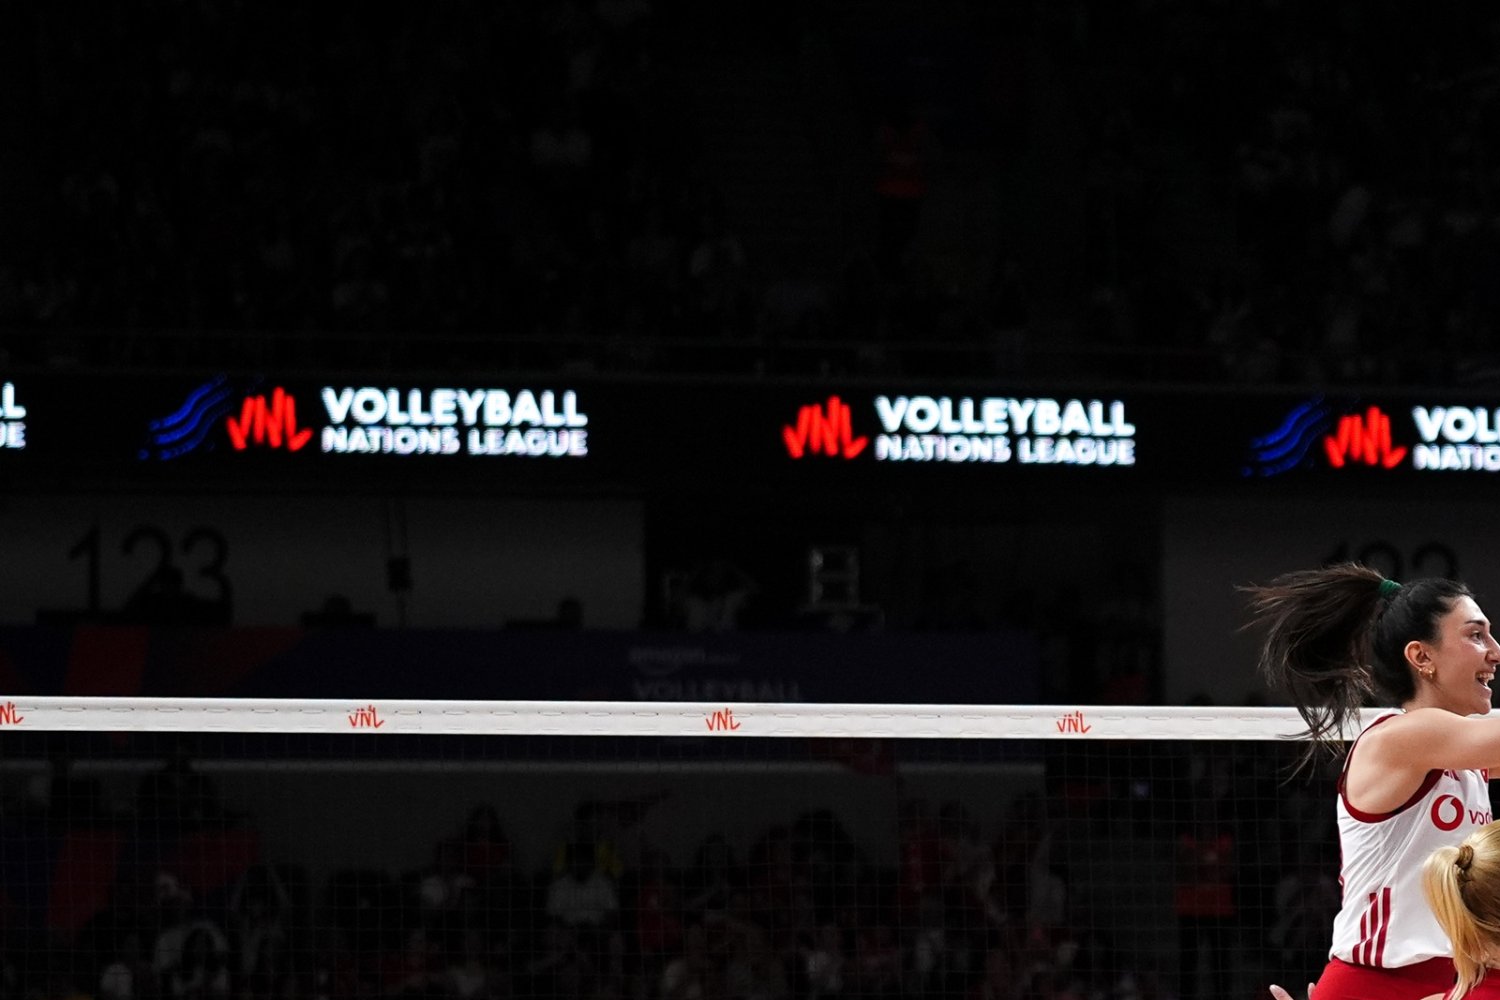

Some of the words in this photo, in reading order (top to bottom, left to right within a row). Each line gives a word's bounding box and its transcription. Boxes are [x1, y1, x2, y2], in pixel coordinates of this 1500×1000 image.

[321, 387, 588, 427] VOLLEYBALL
[876, 396, 1136, 437] VOLLEYBALL
[321, 427, 461, 454] NATIONS
[468, 429, 588, 456] LEAGUE
[876, 434, 1012, 462] NATIONS
[1018, 438, 1136, 466] LEAGUE
